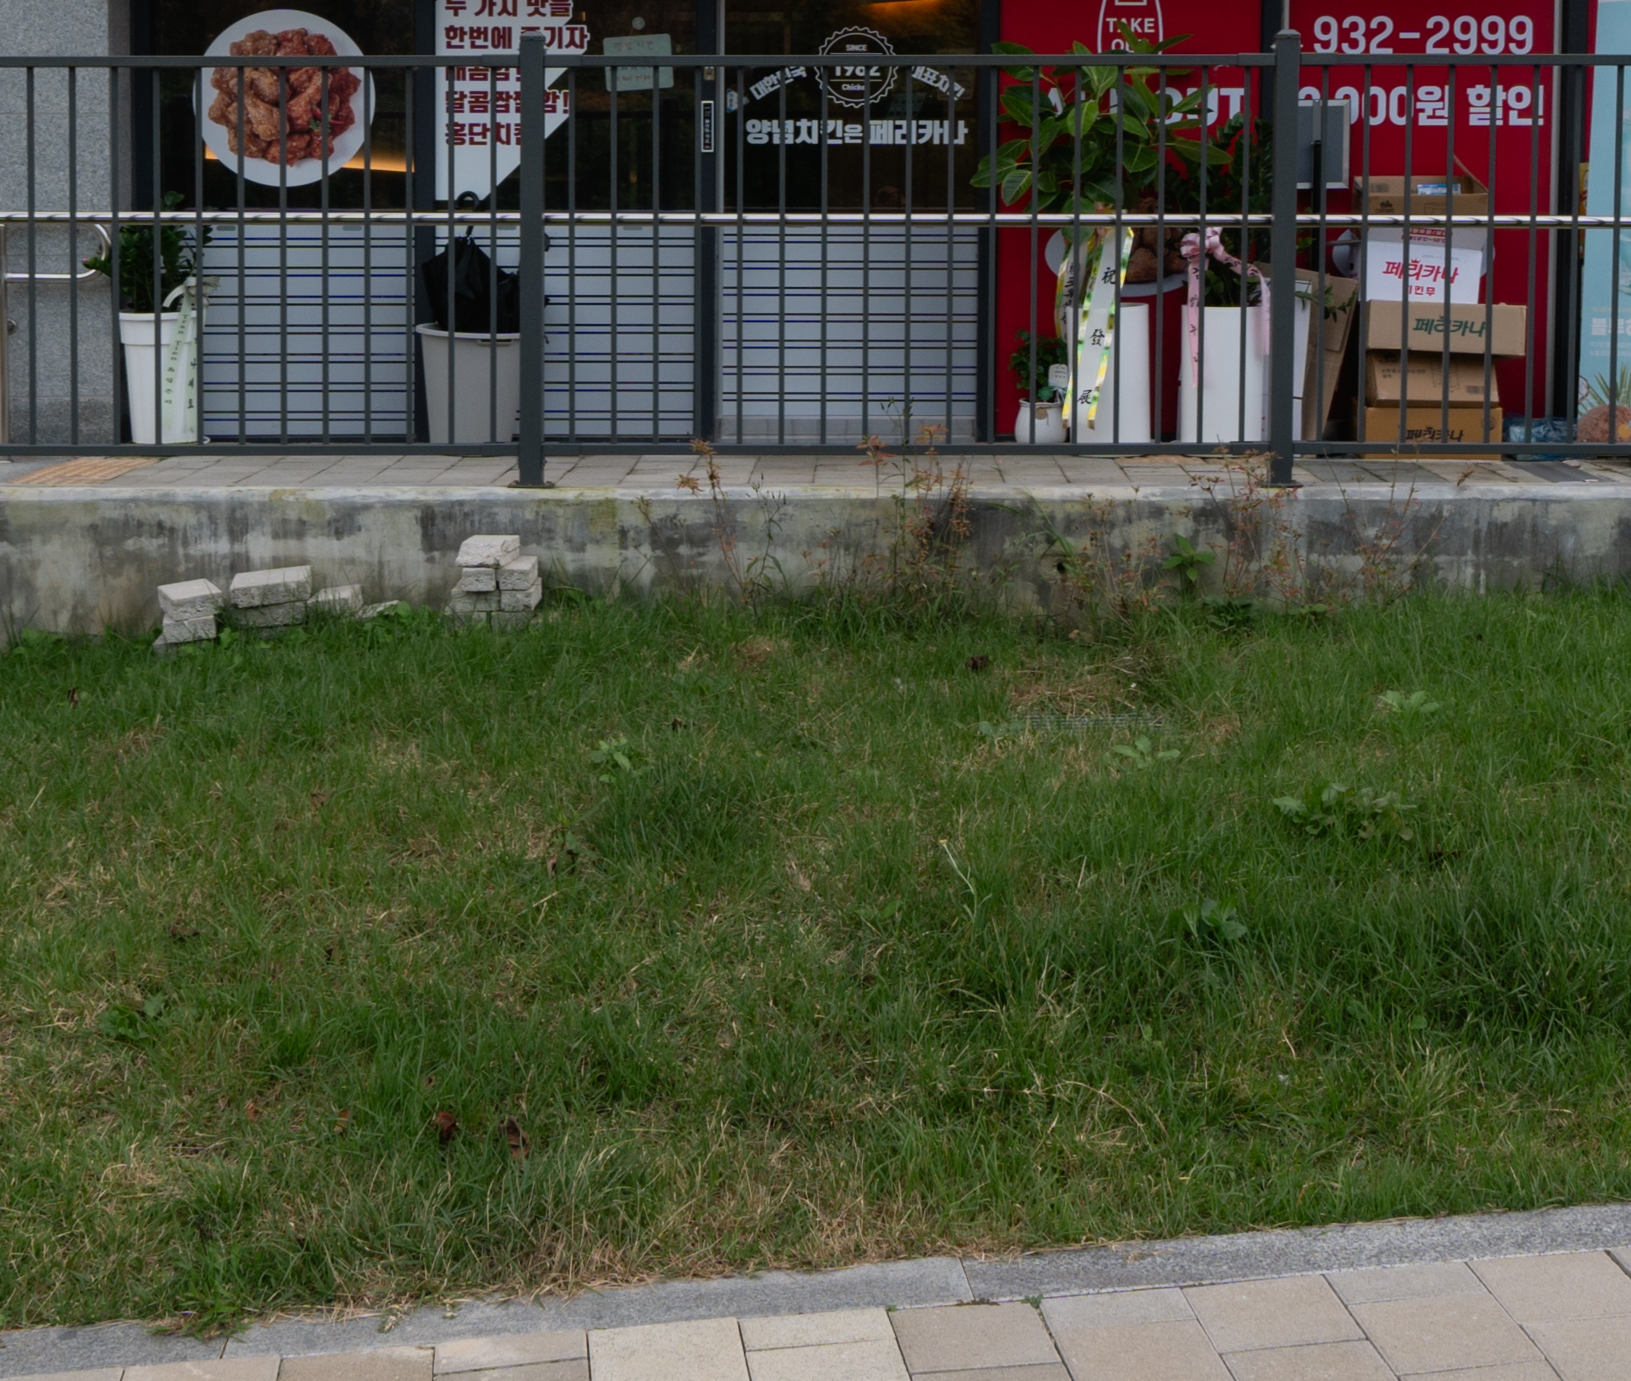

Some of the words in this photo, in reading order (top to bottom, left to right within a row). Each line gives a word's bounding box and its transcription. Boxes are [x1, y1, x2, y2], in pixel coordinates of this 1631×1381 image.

[445, 25, 512, 49] 한번에
[521, 26, 588, 49] 기자
[1313, 16, 1534, 55] 932-2999
[745, 119, 863, 144] 양념치킨은
[868, 119, 968, 145] 페리카나
[1382, 260, 1459, 284] 페리카나
